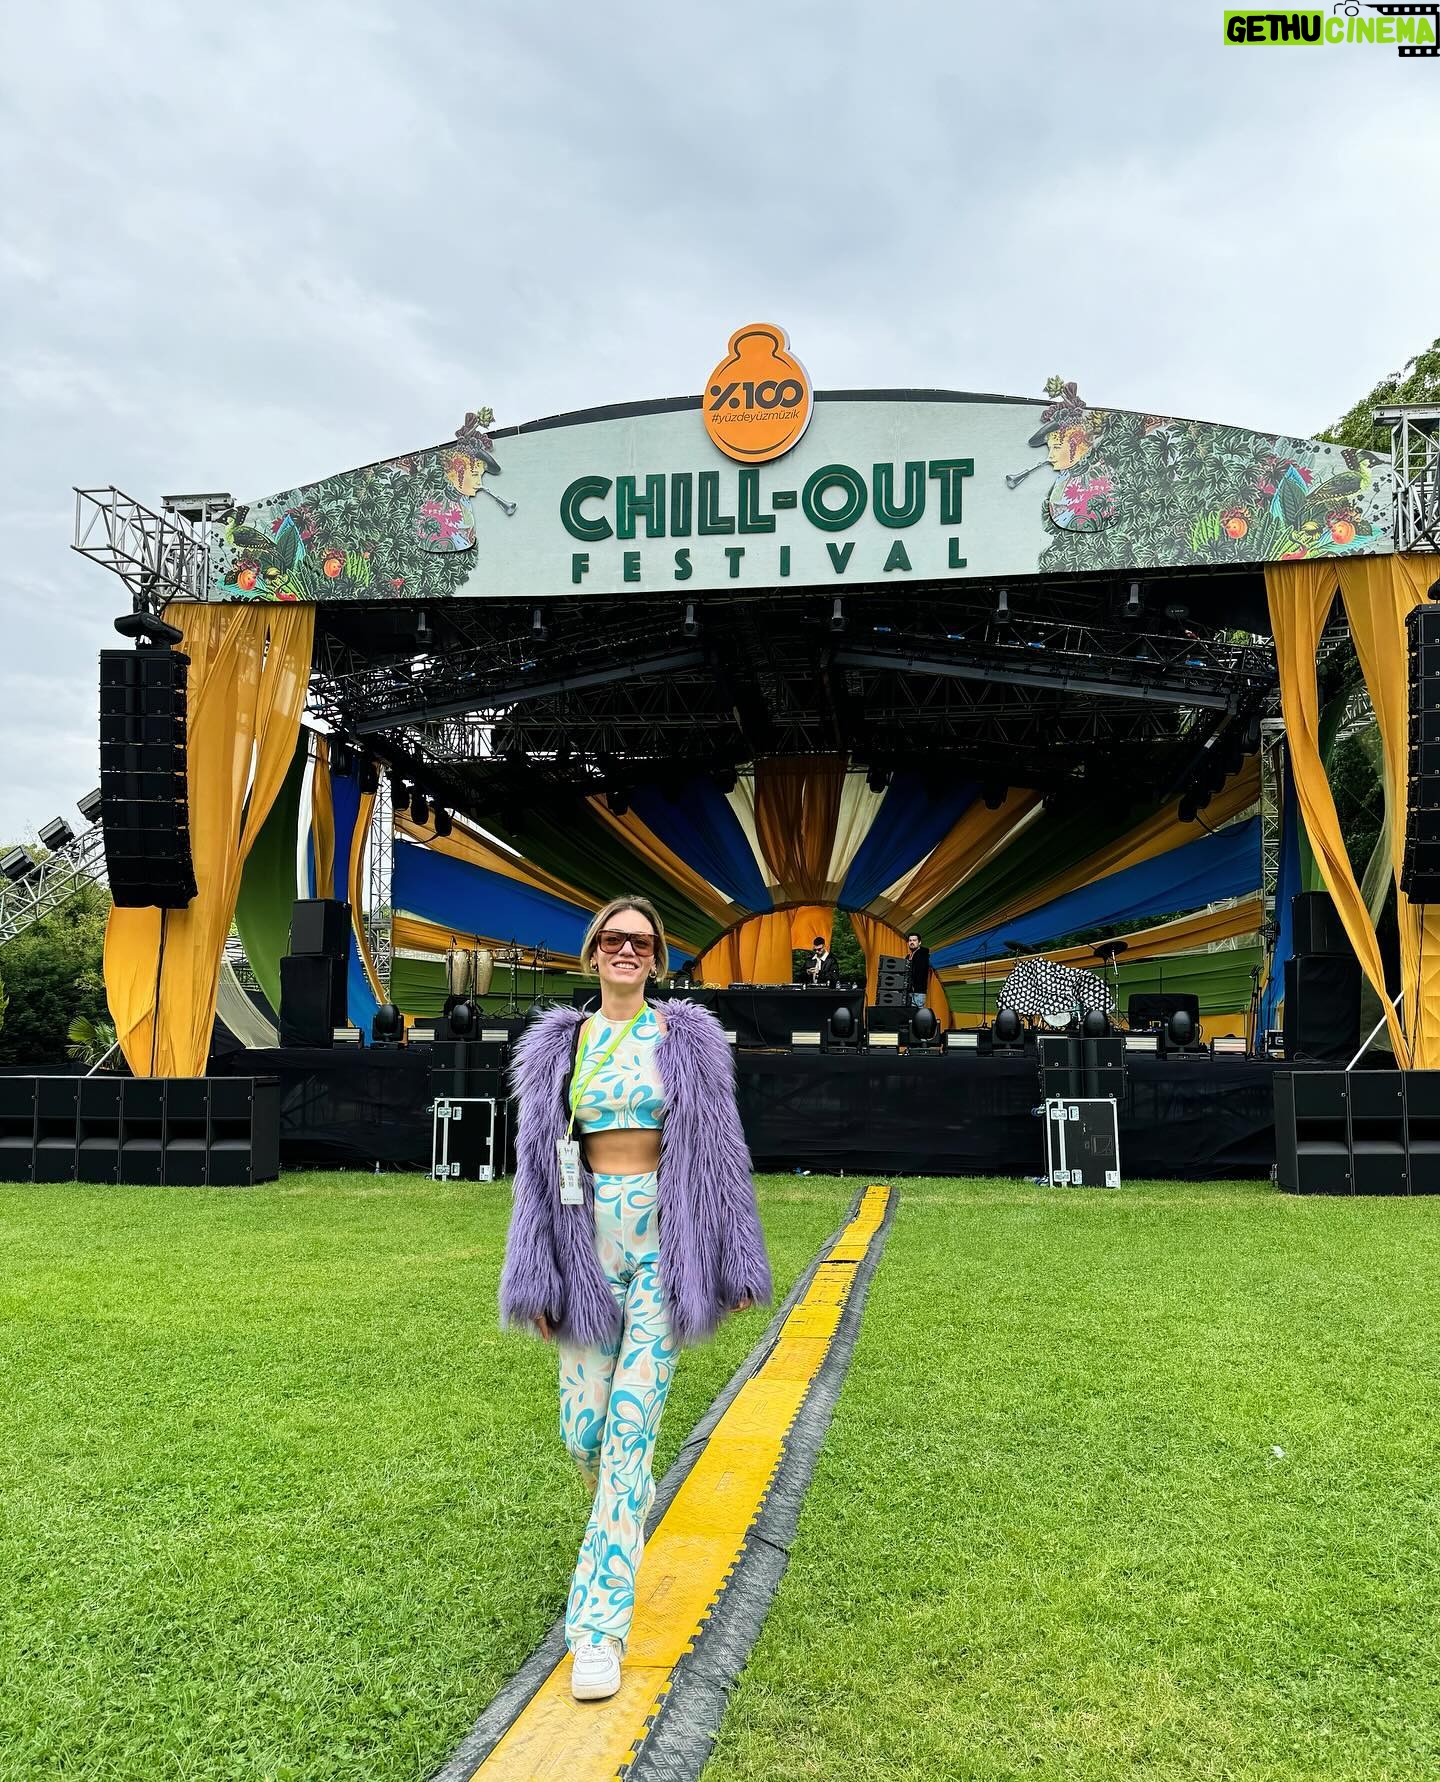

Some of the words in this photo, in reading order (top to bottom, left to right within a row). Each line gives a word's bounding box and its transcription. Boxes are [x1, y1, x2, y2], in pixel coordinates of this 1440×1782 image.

[711, 408, 800, 424] #yüzdeyüzmüzik
[560, 458, 975, 541] CHILL-OUT
[572, 537, 968, 583] FESTIVAL
